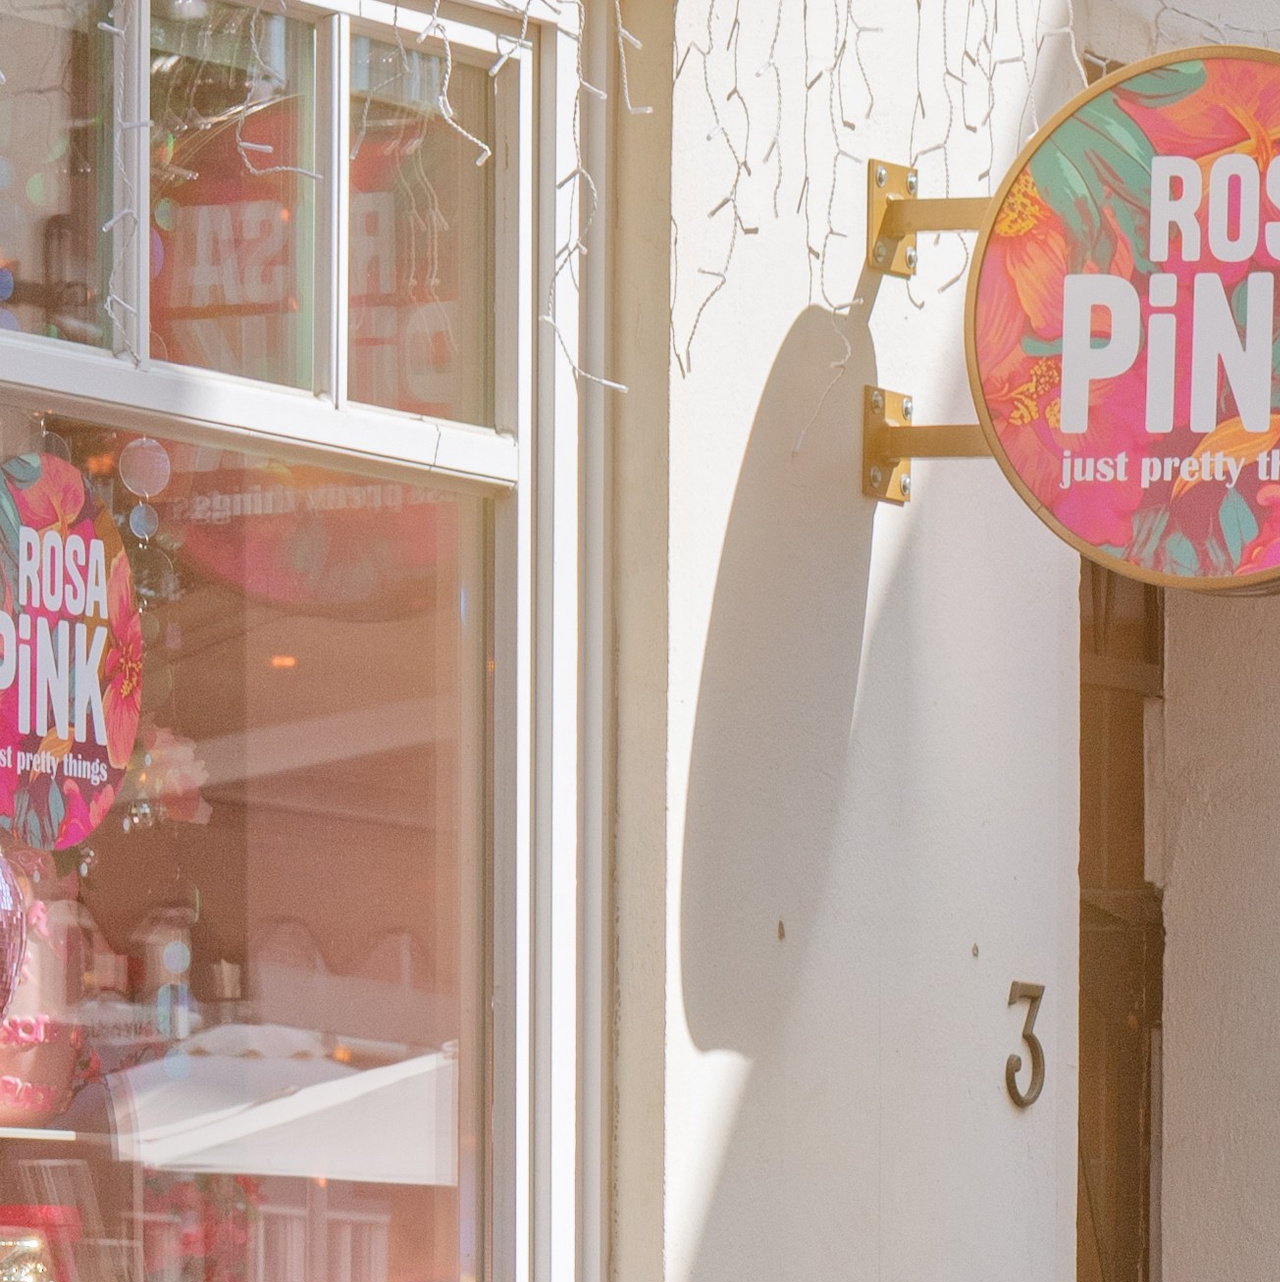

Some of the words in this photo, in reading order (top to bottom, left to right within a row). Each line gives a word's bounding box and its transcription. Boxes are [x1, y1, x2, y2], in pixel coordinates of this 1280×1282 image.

[1059, 450, 1128, 489] just
[1141, 450, 1246, 489] pretty
[19, 526, 109, 619] ROSA
[17, 750, 59, 776] pretty
[62, 754, 108, 787] things
[1005, 980, 1045, 1108] 3
